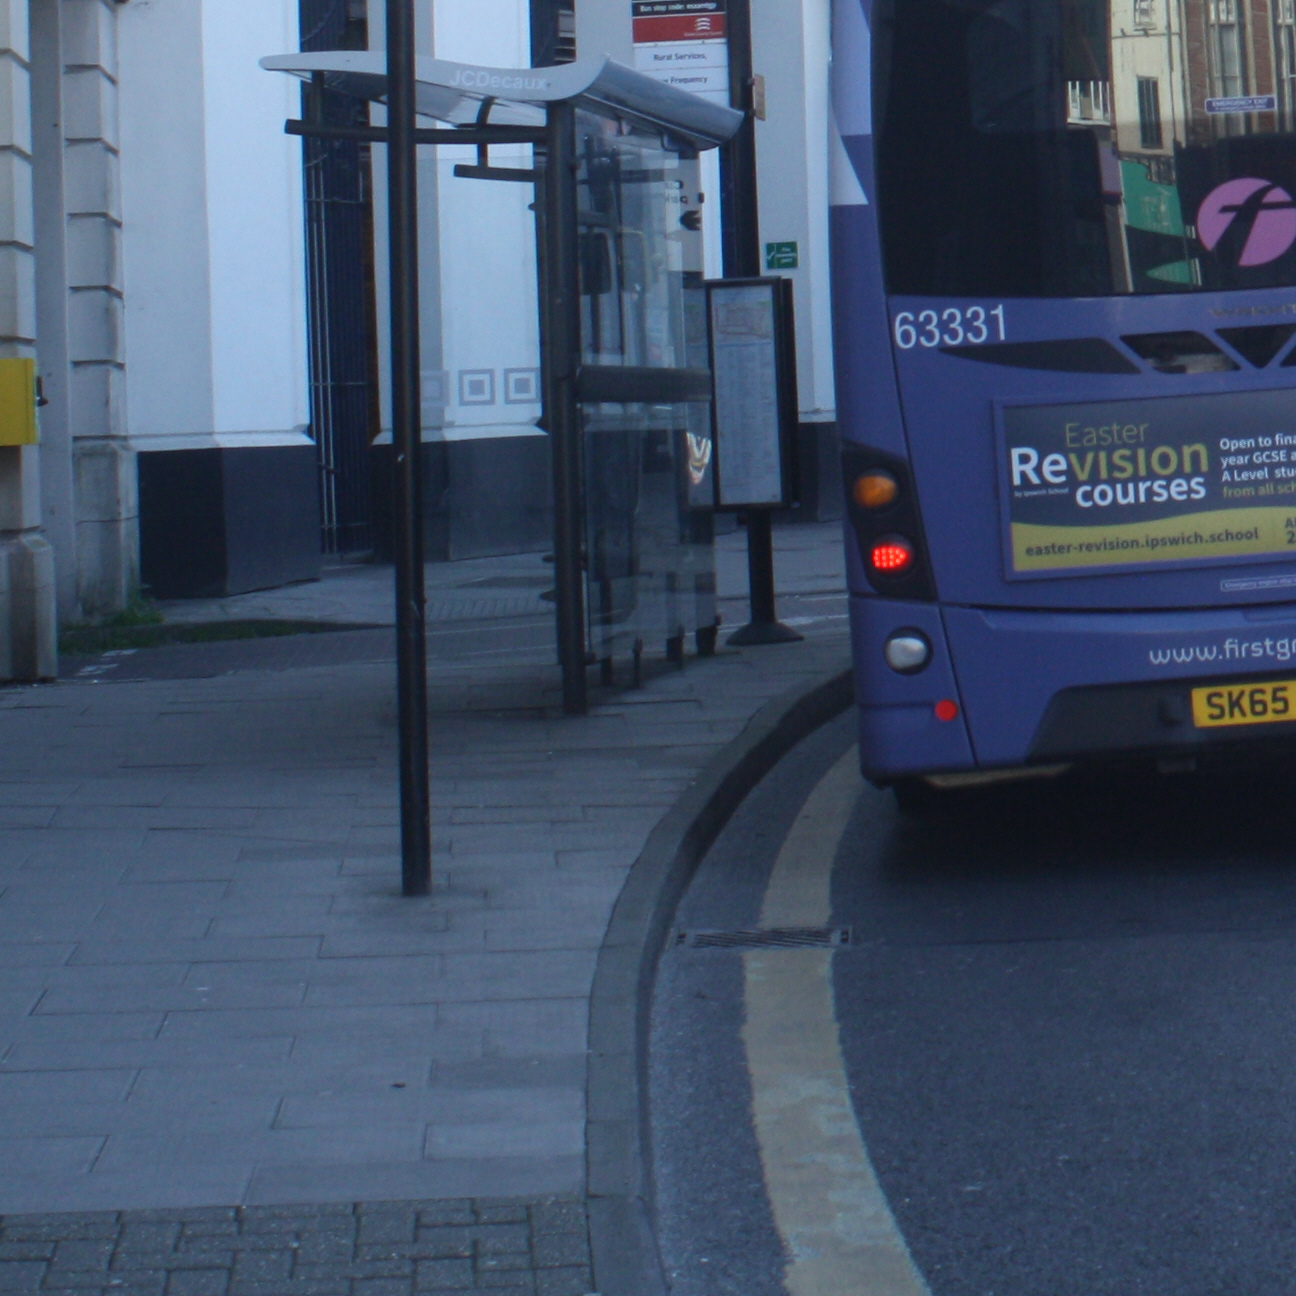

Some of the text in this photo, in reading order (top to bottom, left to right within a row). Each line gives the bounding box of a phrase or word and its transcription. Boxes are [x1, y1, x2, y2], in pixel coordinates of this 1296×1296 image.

[653, 53, 673, 62] Rural
[450, 70, 548, 90] JCDecaux
[670, 76, 708, 85] Frequency
[894, 304, 1007, 349] 63331
[1065, 422, 1149, 448] Easter
[1220, 436, 1255, 453] Open
[1257, 434, 1272, 448] to
[1010, 442, 1210, 486] Revision
[1220, 454, 1250, 470] year
[1252, 450, 1288, 464] GCSE
[1221, 471, 1232, 483] A
[1234, 467, 1269, 482] Level
[1076, 476, 1207, 508] courses
[1223, 484, 1255, 499] from
[1257, 481, 1275, 497] all
[1025, 527, 1260, 557] easter-revision.ipswich.school
[1205, 685, 1291, 722] SK65
